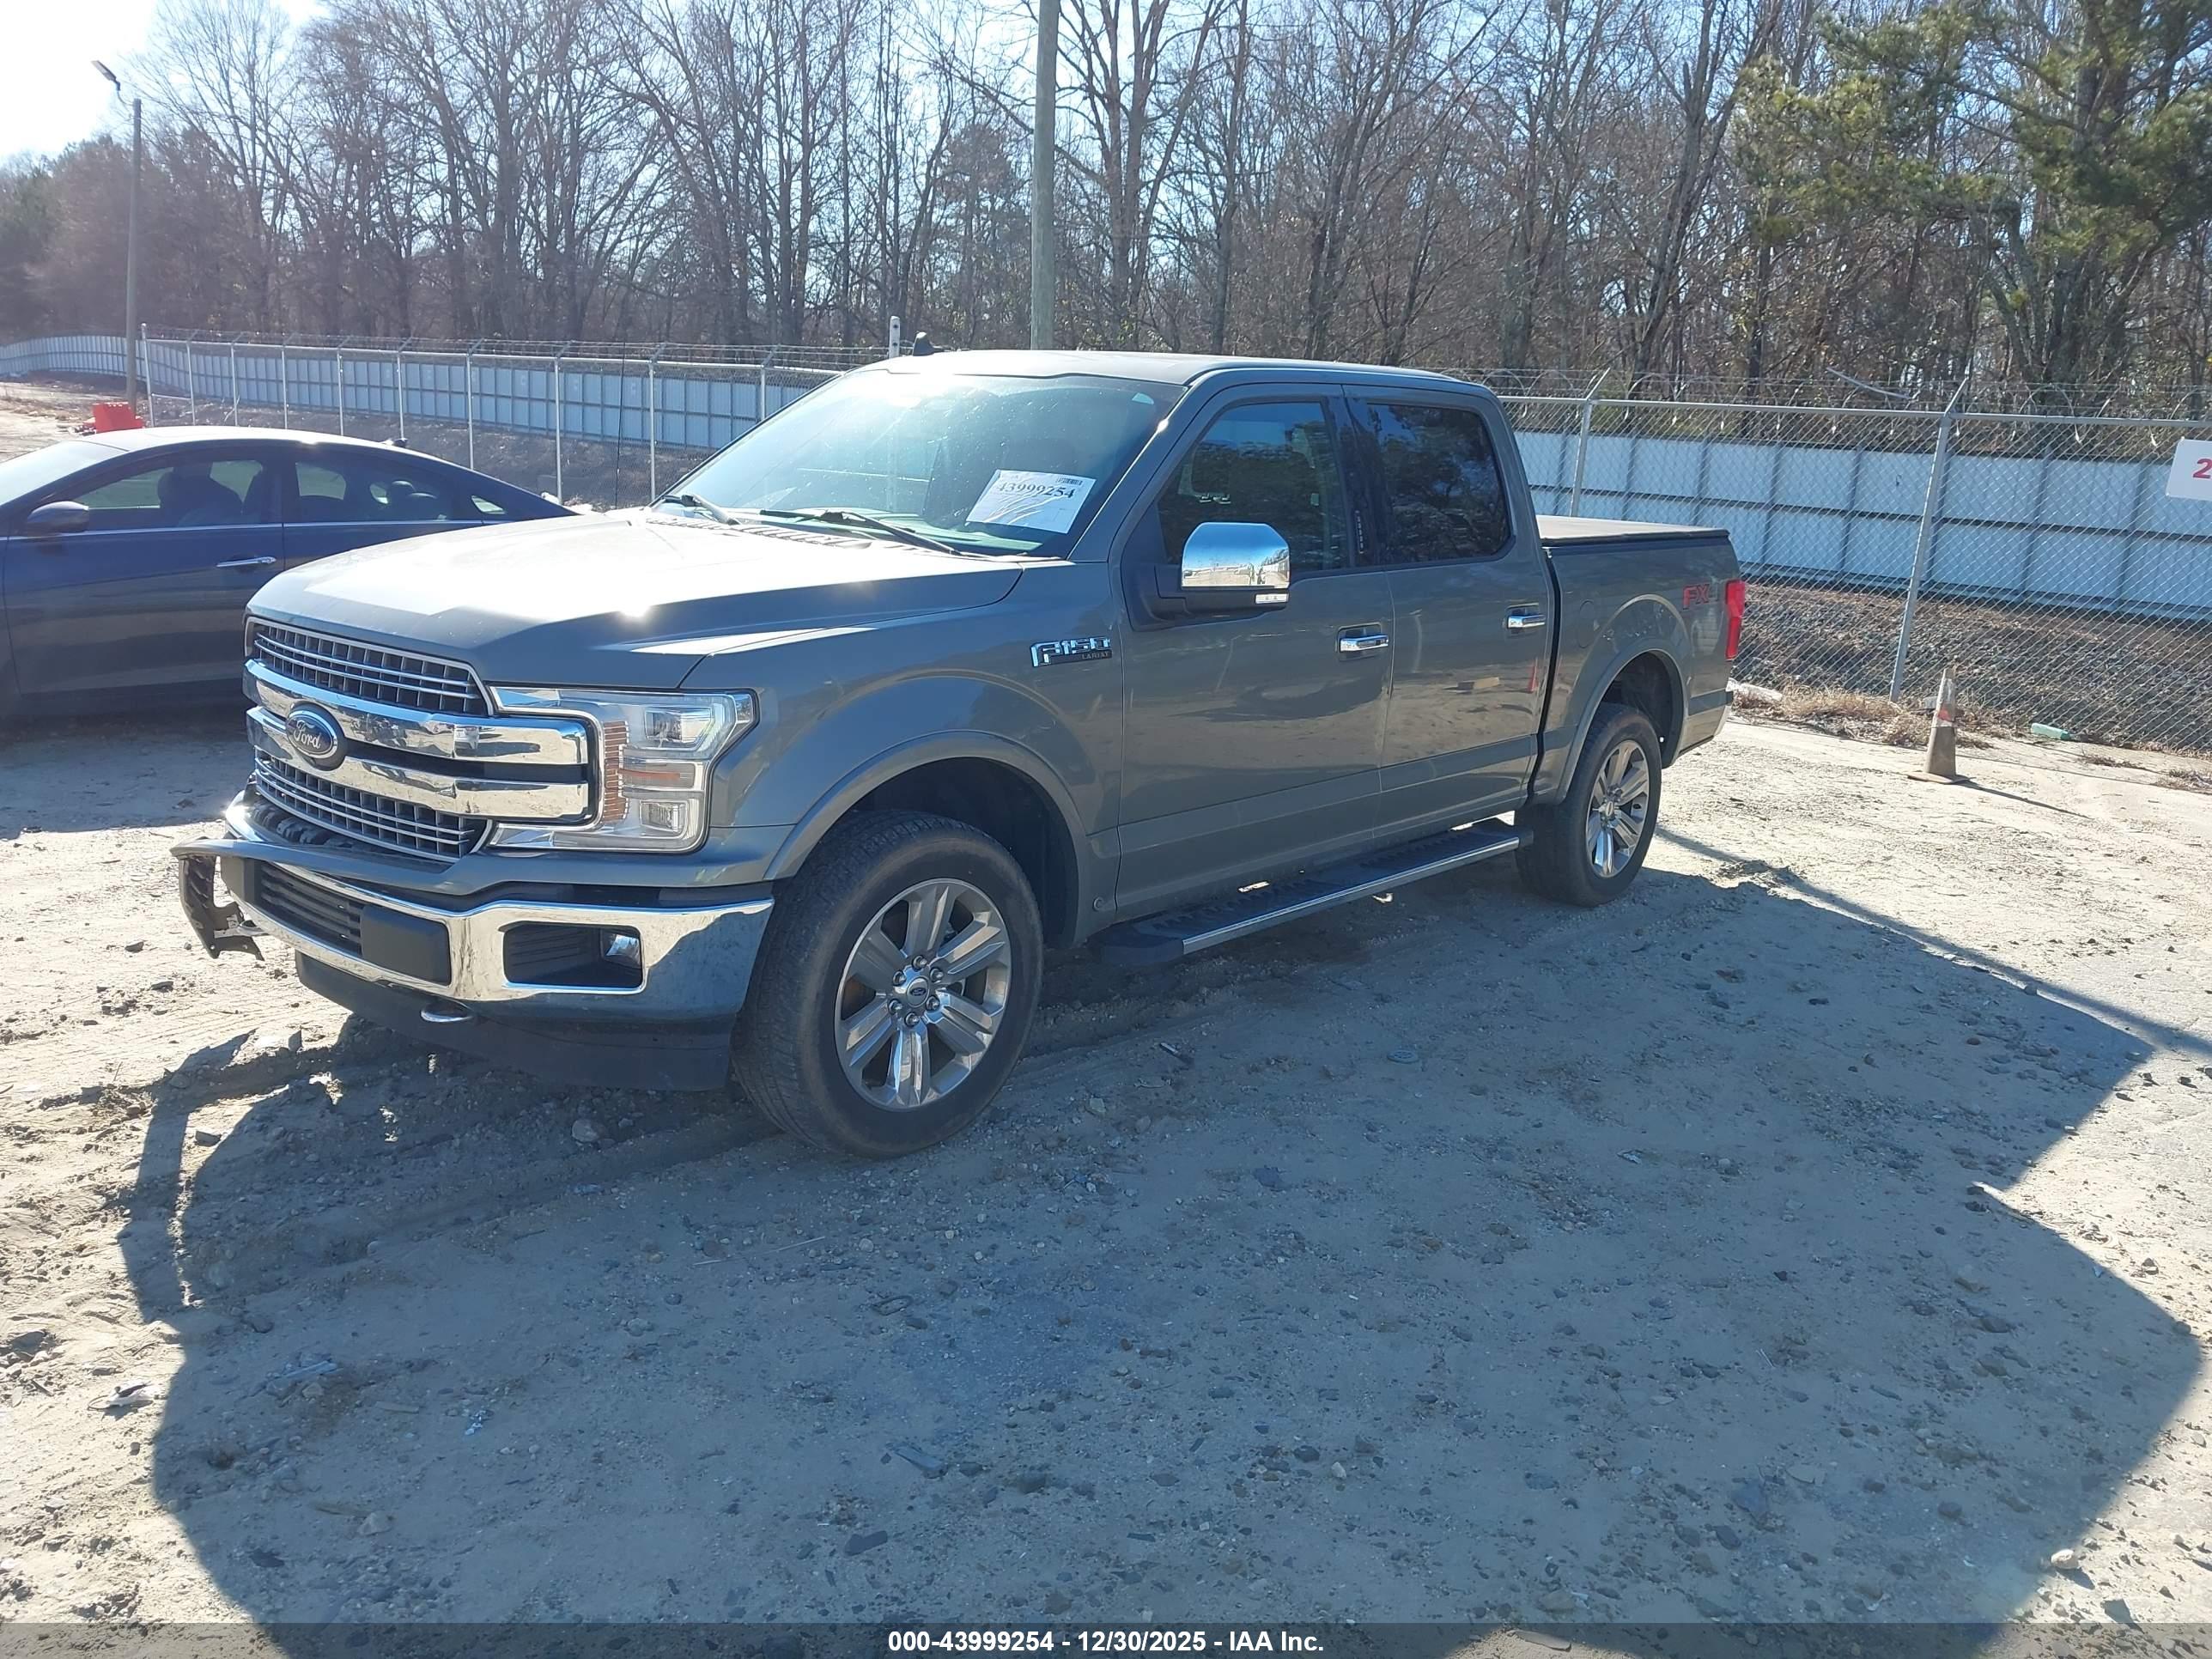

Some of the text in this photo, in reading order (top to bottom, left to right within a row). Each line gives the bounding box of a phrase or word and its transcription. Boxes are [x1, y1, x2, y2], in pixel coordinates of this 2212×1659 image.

[2192, 458, 2212, 479] 2
[997, 481, 1076, 499] 43999254
[1082, 651, 1109, 660] LARIAT
[293, 720, 322, 750] Ford
